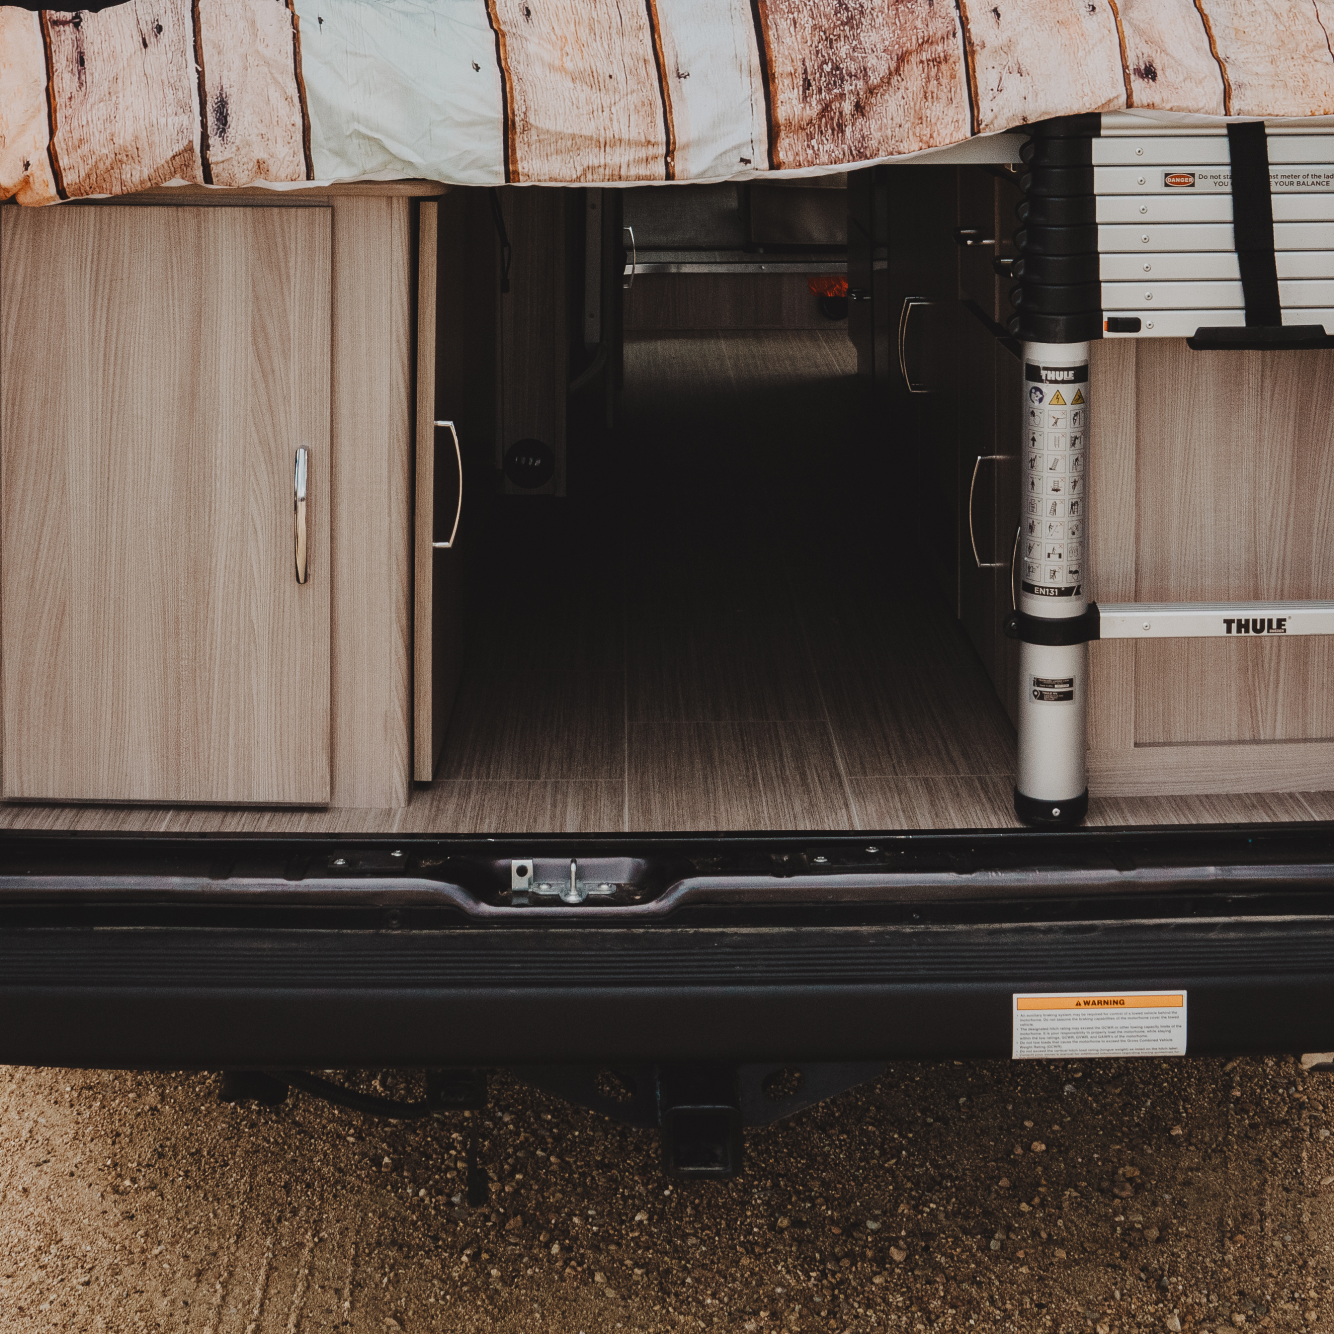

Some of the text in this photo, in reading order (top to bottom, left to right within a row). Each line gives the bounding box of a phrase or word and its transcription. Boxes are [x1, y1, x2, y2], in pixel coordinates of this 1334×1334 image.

[1041, 370, 1075, 381] THULE
[1034, 586, 1058, 596] EN131
[1223, 618, 1287, 634] THULE
